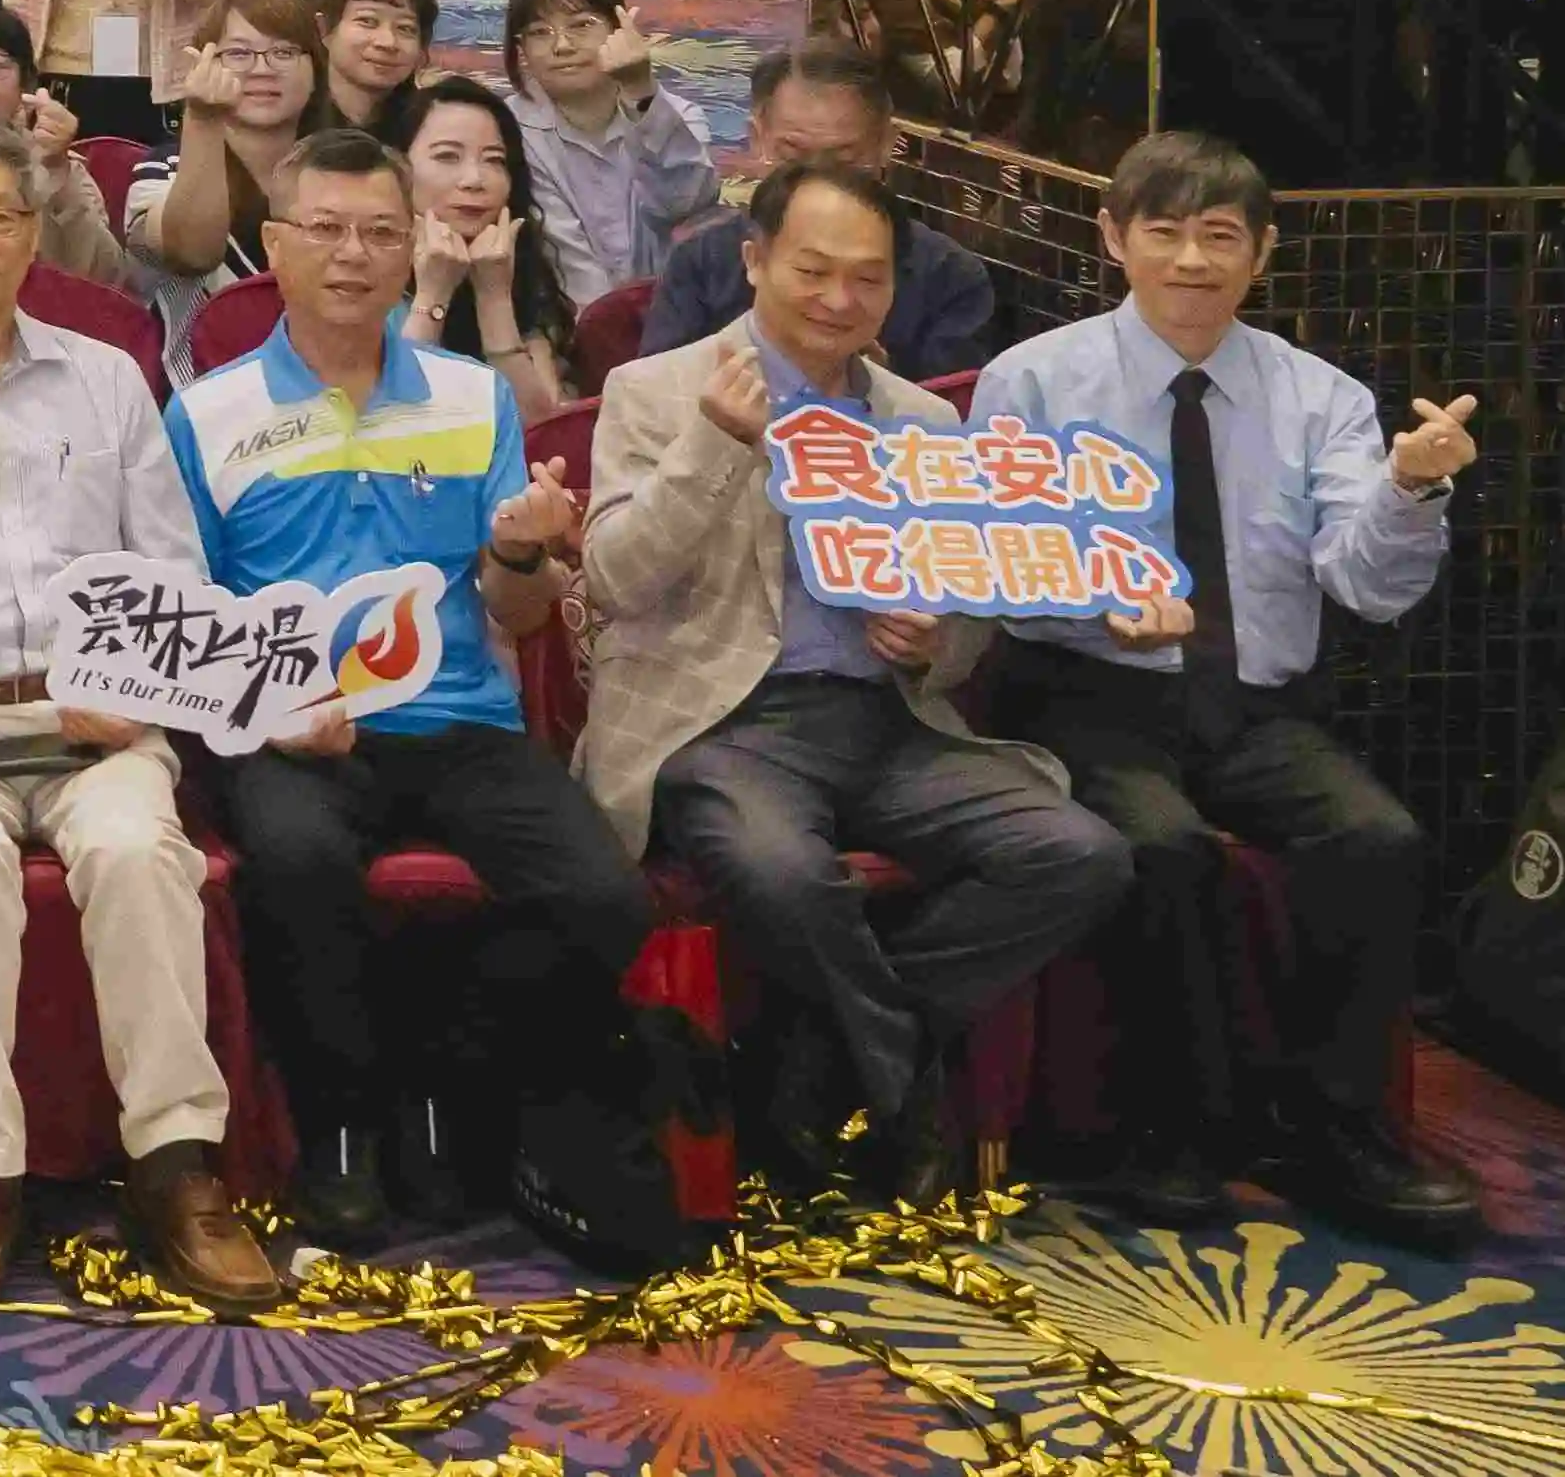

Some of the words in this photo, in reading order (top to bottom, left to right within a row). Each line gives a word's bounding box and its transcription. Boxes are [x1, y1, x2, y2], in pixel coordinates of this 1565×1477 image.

[771, 407, 1160, 508] 食在安心
[809, 517, 1178, 604] 吃得開心
[68, 575, 319, 731] 雲林上場
[69, 667, 112, 691] It's
[119, 677, 163, 702] Our
[166, 686, 224, 714] Time
